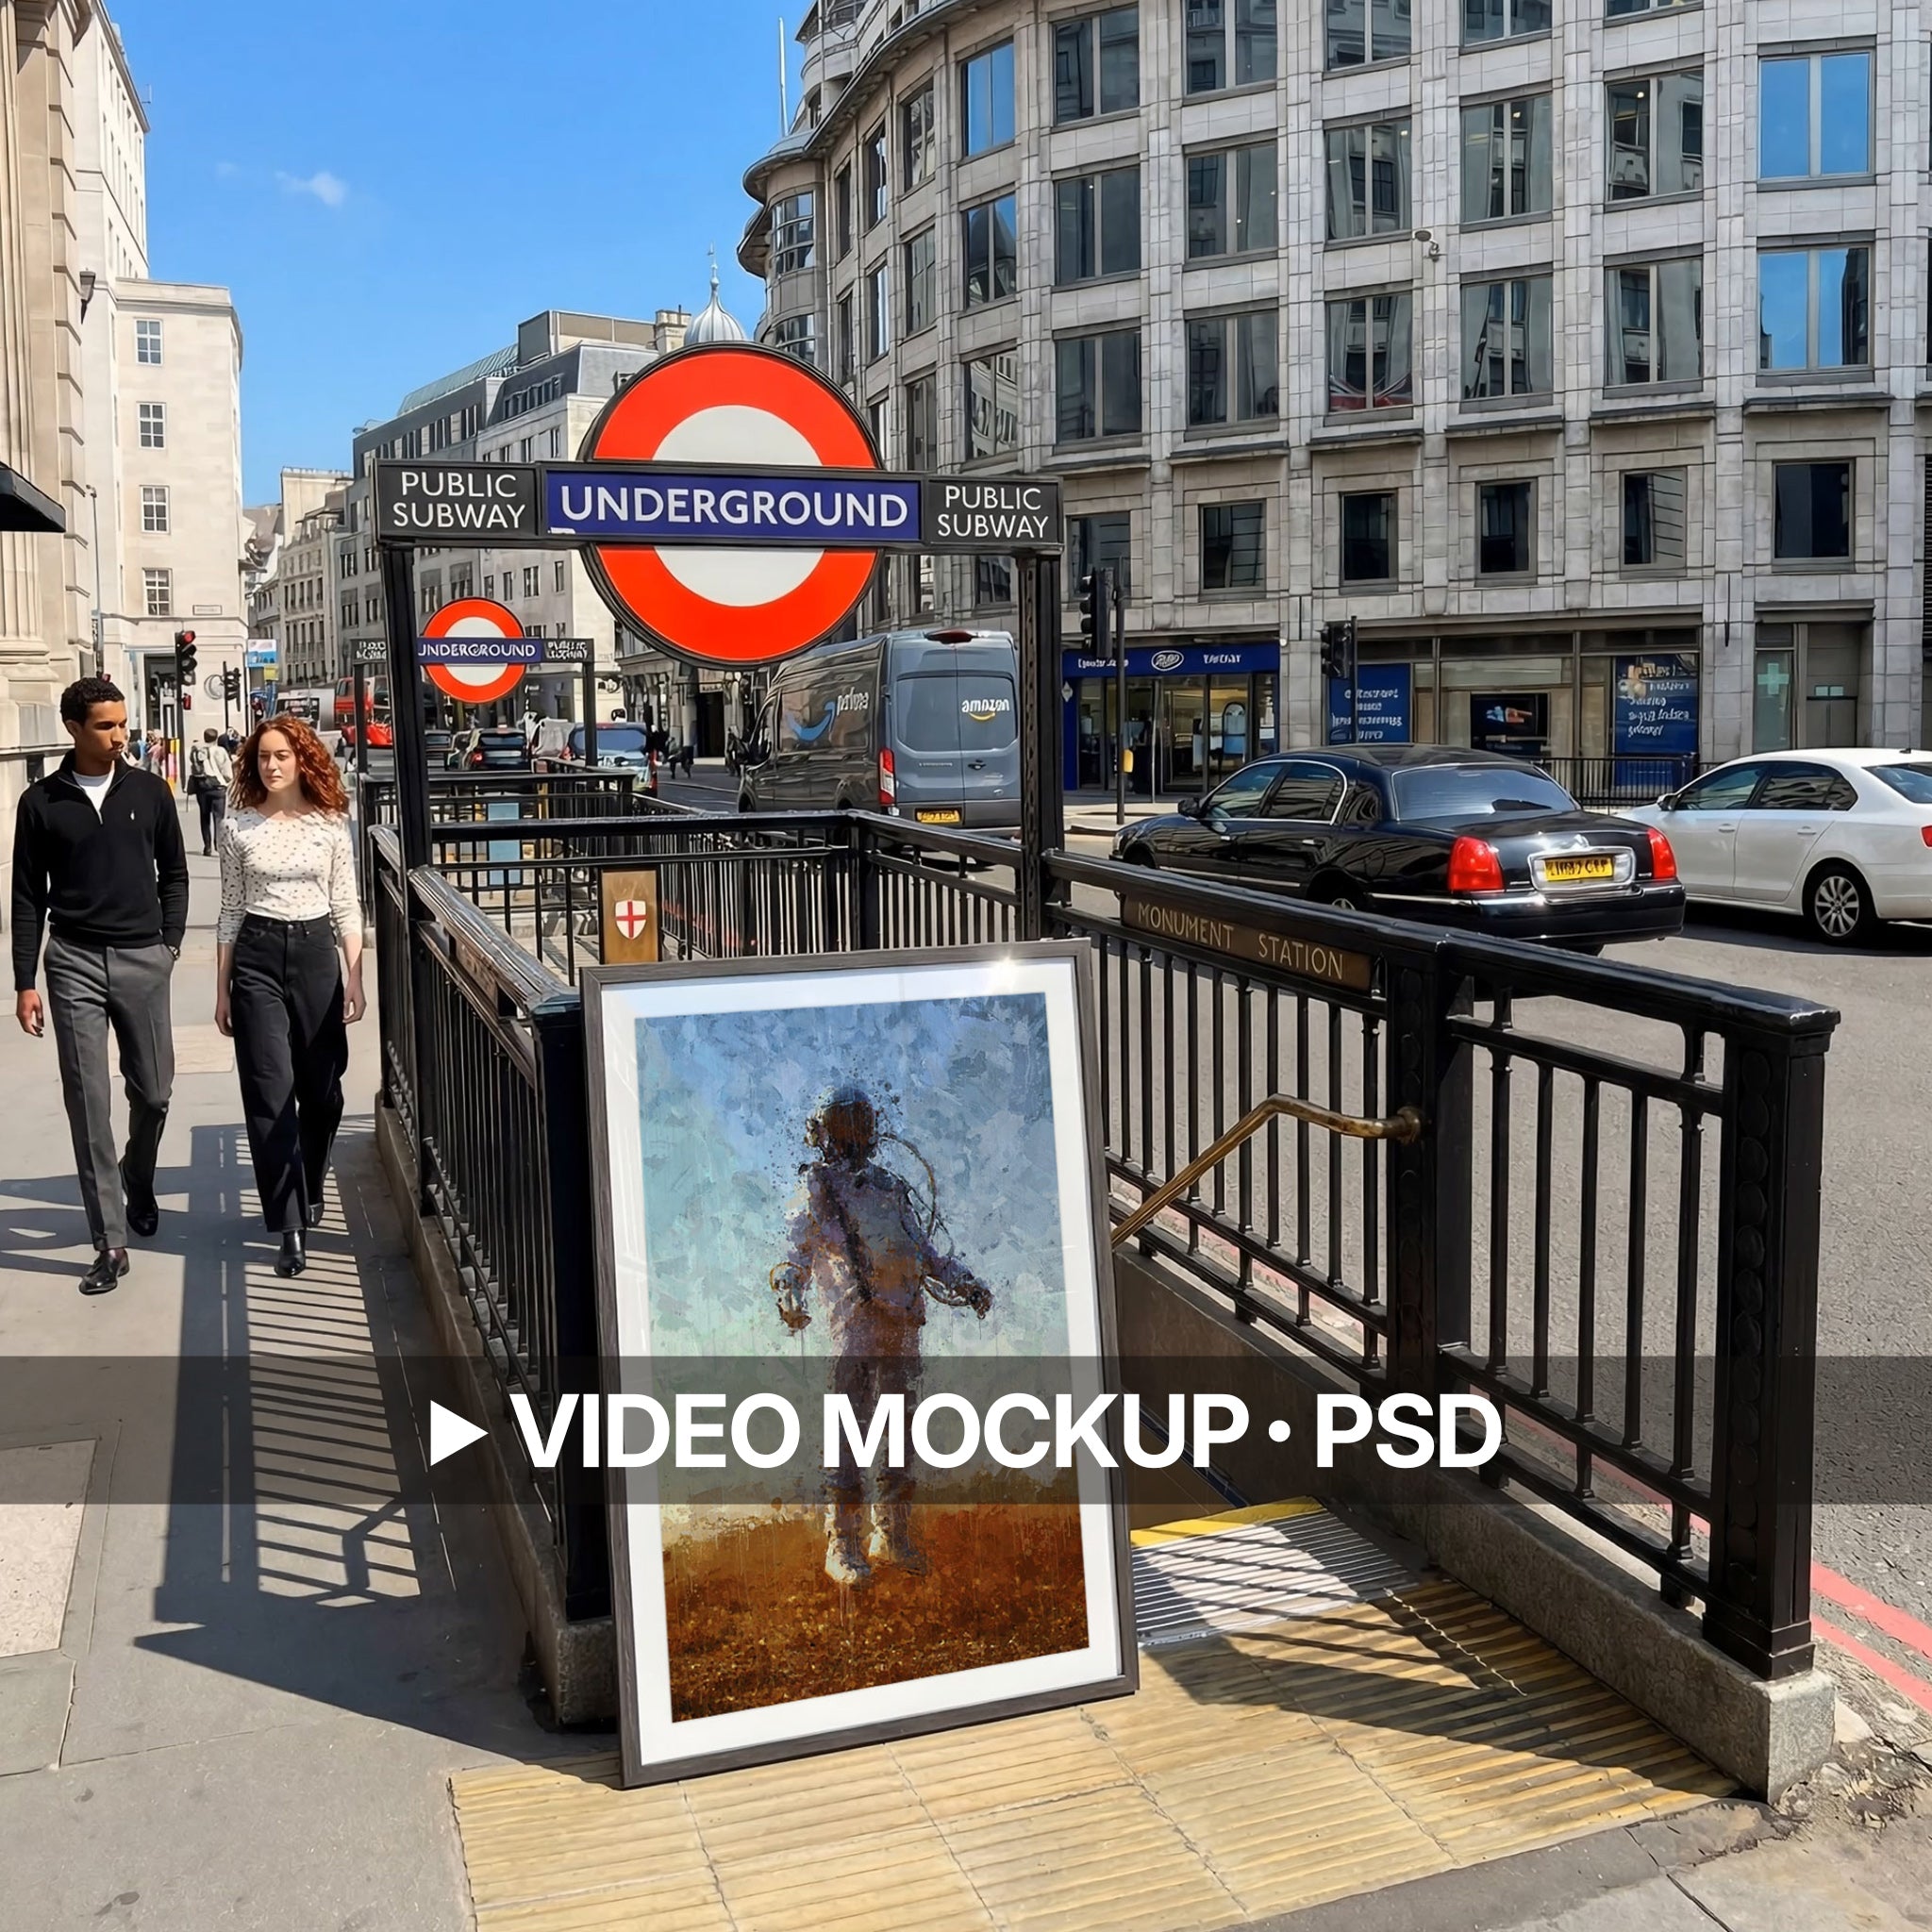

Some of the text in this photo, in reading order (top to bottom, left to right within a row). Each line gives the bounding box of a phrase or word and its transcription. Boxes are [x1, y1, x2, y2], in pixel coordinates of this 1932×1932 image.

[401, 471, 517, 498] PUBLIC
[945, 485, 1041, 510] PUBLIC
[392, 502, 525, 529] SUBWAY
[560, 485, 908, 527] UNDERGROUND
[937, 513, 1049, 539] SUBWAY
[1138, 903, 1344, 981] MONUMENT STATION
